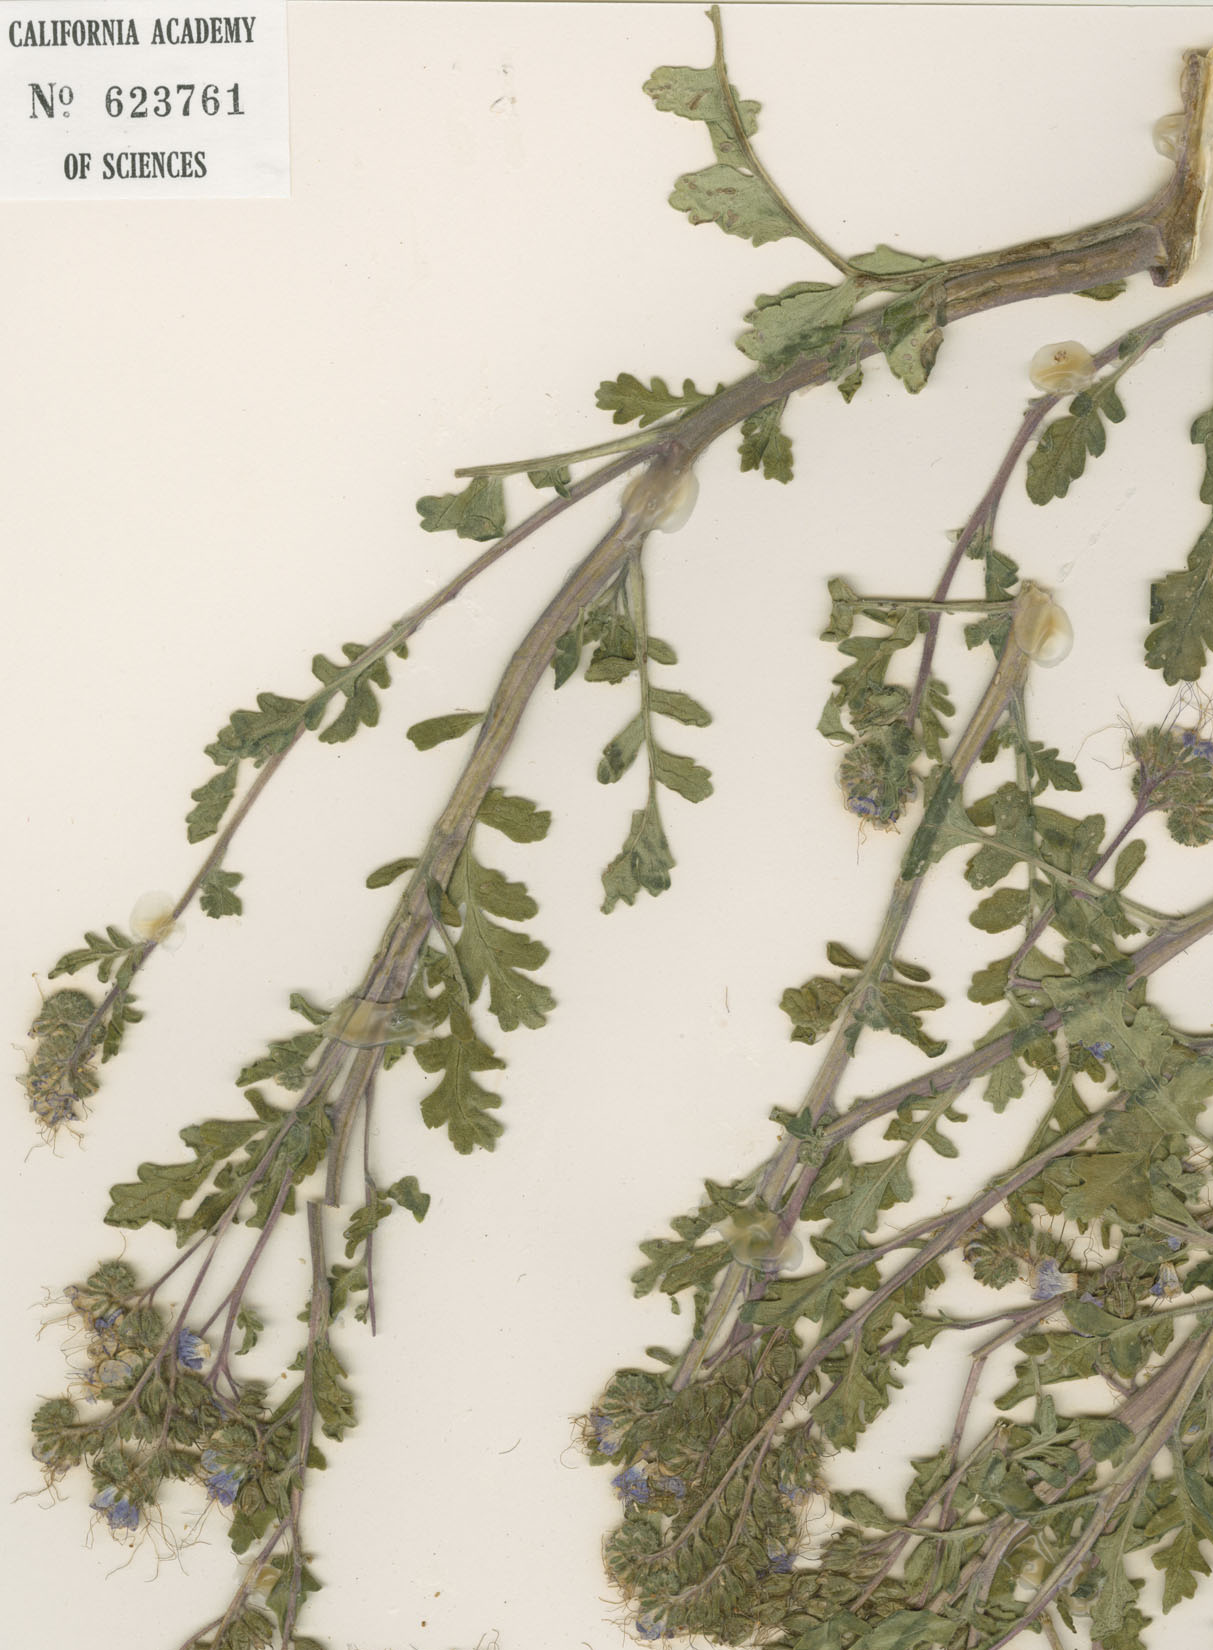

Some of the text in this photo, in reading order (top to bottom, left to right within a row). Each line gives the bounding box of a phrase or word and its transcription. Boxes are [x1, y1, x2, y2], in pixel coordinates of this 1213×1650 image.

[8, 16, 256, 48] CALIFORNIA ACADEMY
[105, 83, 246, 119] 623761
[63, 151, 207, 180] OF SCIENCES
